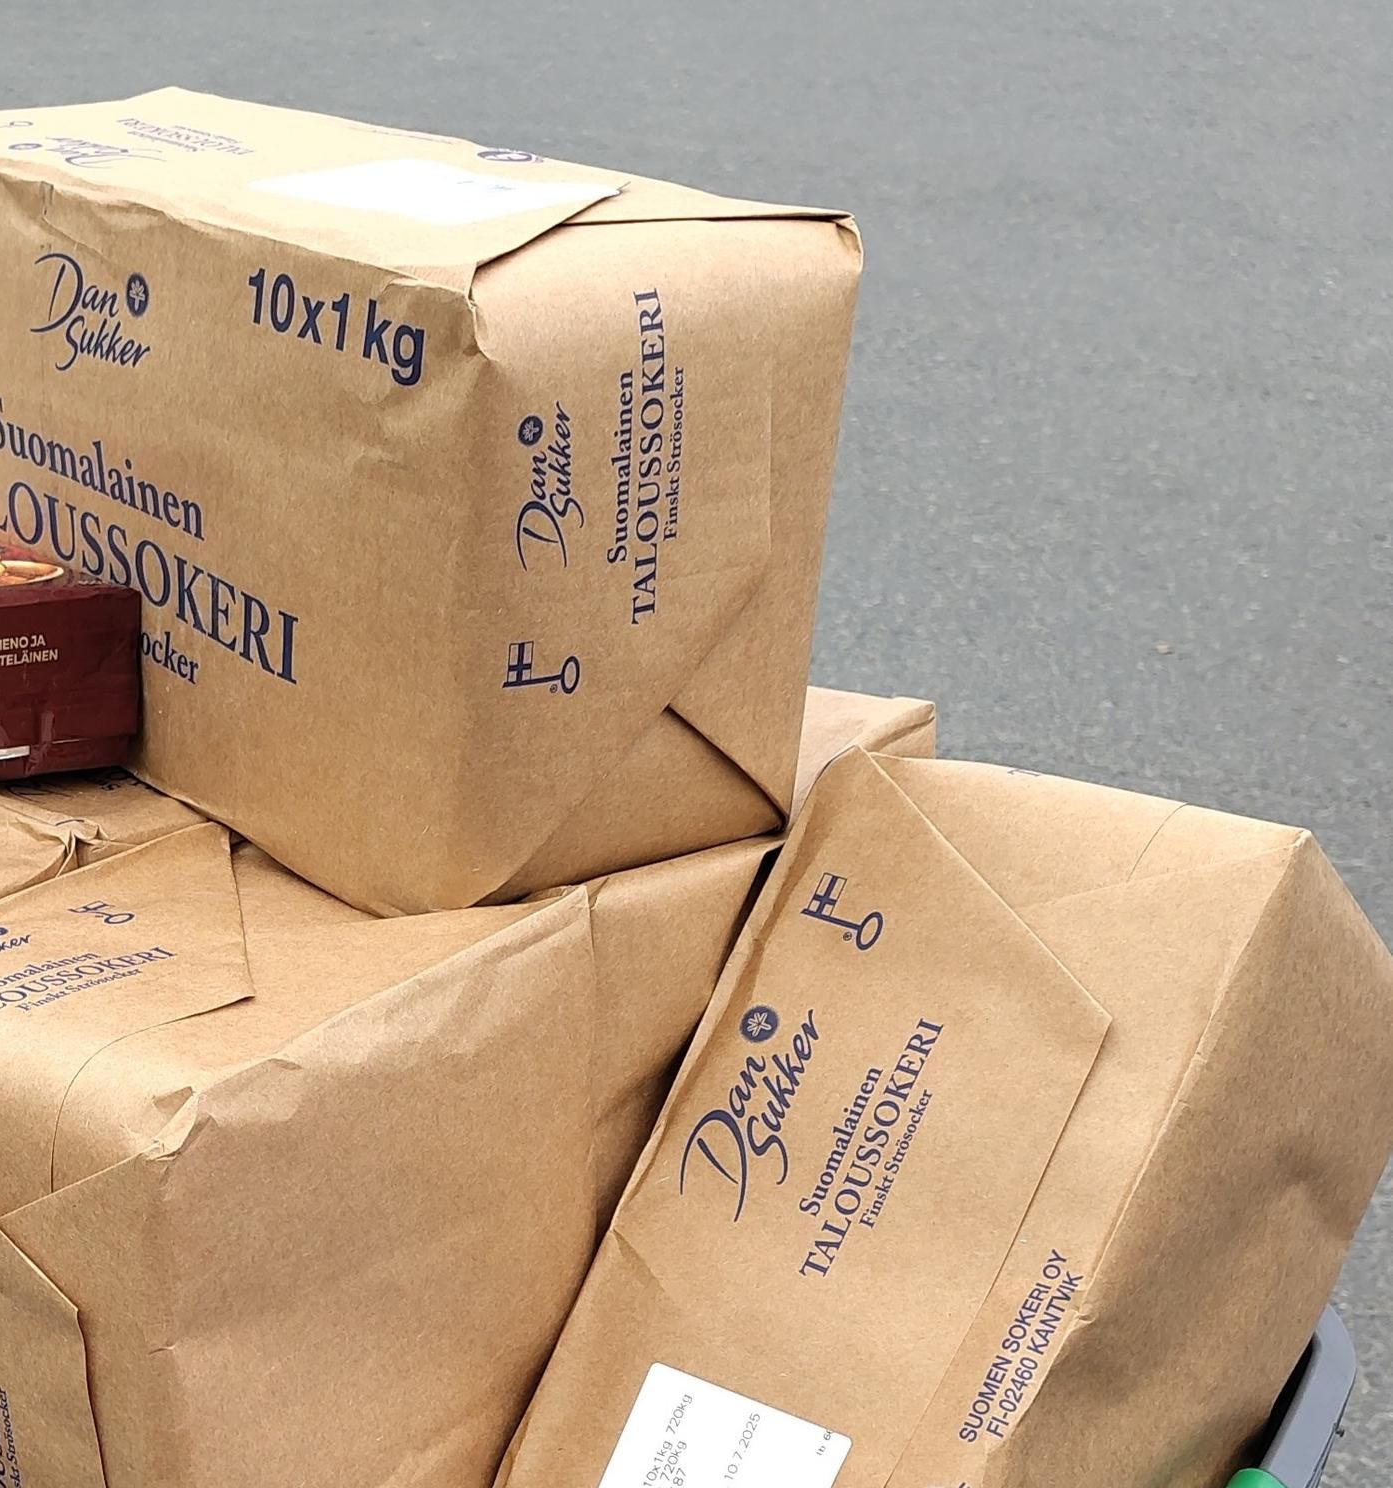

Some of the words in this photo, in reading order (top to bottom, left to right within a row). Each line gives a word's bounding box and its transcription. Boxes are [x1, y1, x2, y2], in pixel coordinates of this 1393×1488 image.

[30, 252, 119, 335] Dan
[54, 316, 151, 371] Sukker
[548, 401, 584, 529] Sukker
[607, 369, 633, 564] Suomalainen
[631, 287, 666, 625] TALOUSSOKERI
[667, 366, 685, 478] Strösocker
[516, 450, 567, 572] Dan
[663, 480, 680, 541] Finskt
[29, 634, 47, 649] JA
[15, 989, 68, 1012] Finskt
[65, 968, 142, 994] Strösocker
[679, 1055, 767, 1223] Dan
[746, 1009, 820, 1186] Sukker
[798, 1018, 945, 1278] TALOUSSOKERI
[799, 1067, 883, 1217] Suomalainen
[858, 1174, 895, 1229] Finskt
[883, 1088, 933, 1176] Strösocker
[959, 1353, 1012, 1443] SUOMEN
[1001, 1282, 1052, 1355] SOKERI
[1042, 1249, 1068, 1281] OY
[986, 1356, 1039, 1439] FI-02460
[1027, 1271, 1085, 1355] KANTVIK
[643, 1440, 674, 1487] 10x1kg
[665, 1394, 693, 1435] 720kg
[659, 1440, 688, 1482] 720kg
[724, 1412, 762, 1481] 10.7.2025
